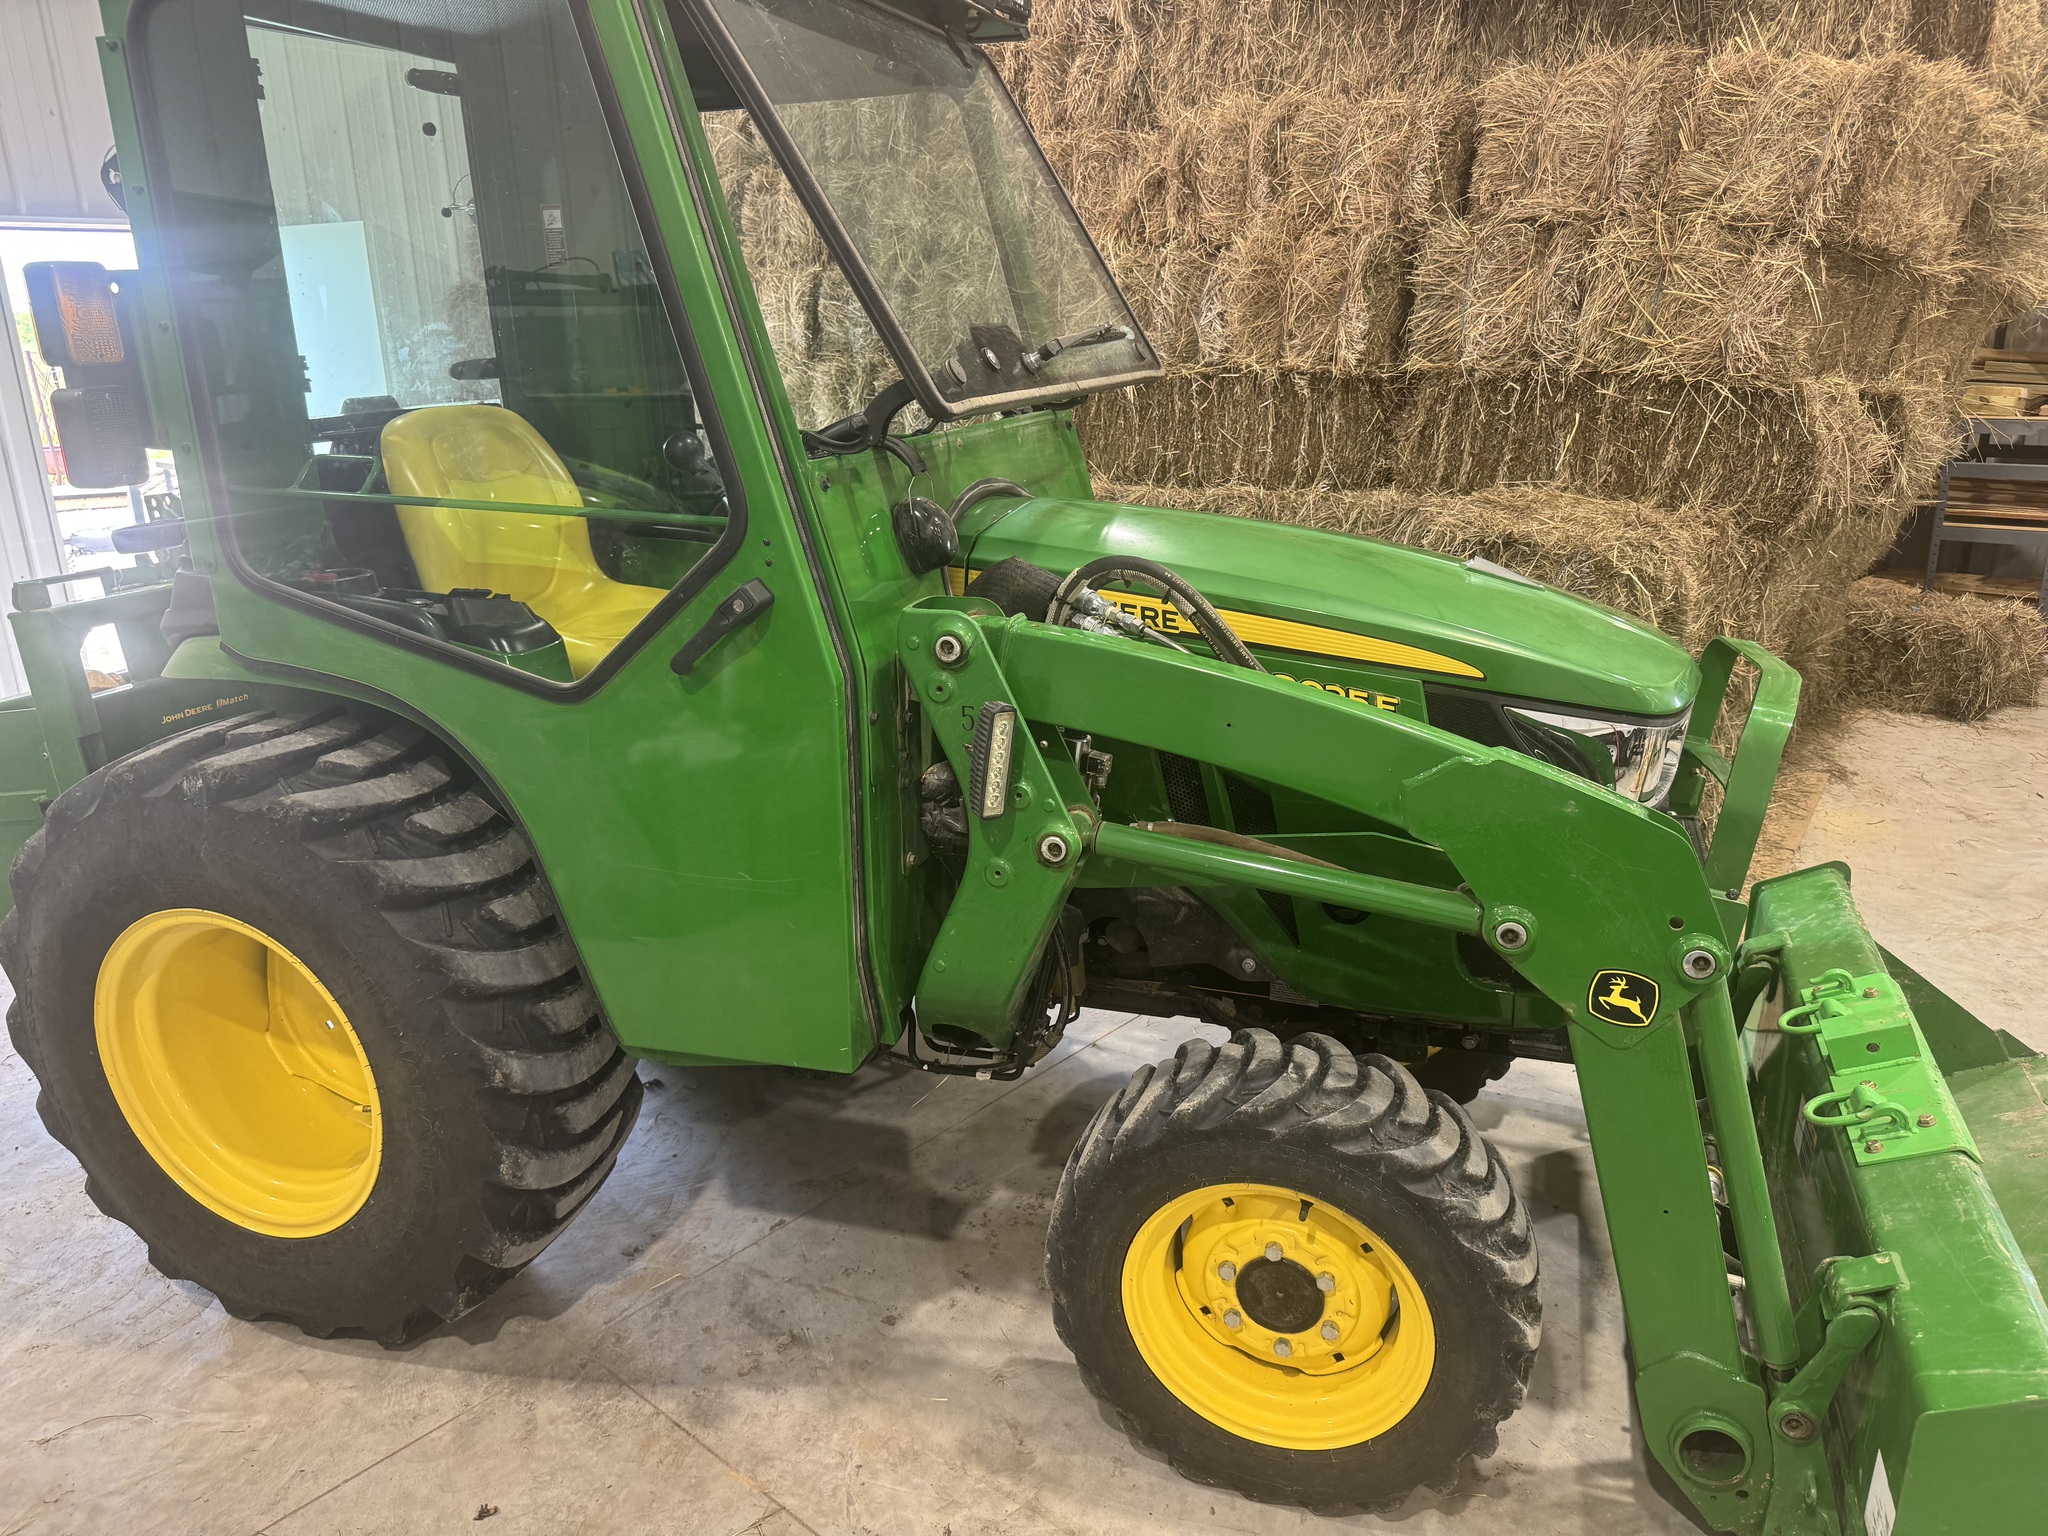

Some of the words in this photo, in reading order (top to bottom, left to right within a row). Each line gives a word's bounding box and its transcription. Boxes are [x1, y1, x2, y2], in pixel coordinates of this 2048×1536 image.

[1215, 619, 1240, 648] RESISTANT
[1238, 647, 1255, 666] FLAME
[161, 712, 184, 724] JOHN
[184, 703, 213, 717] DEERE
[961, 706, 975, 731] 5
